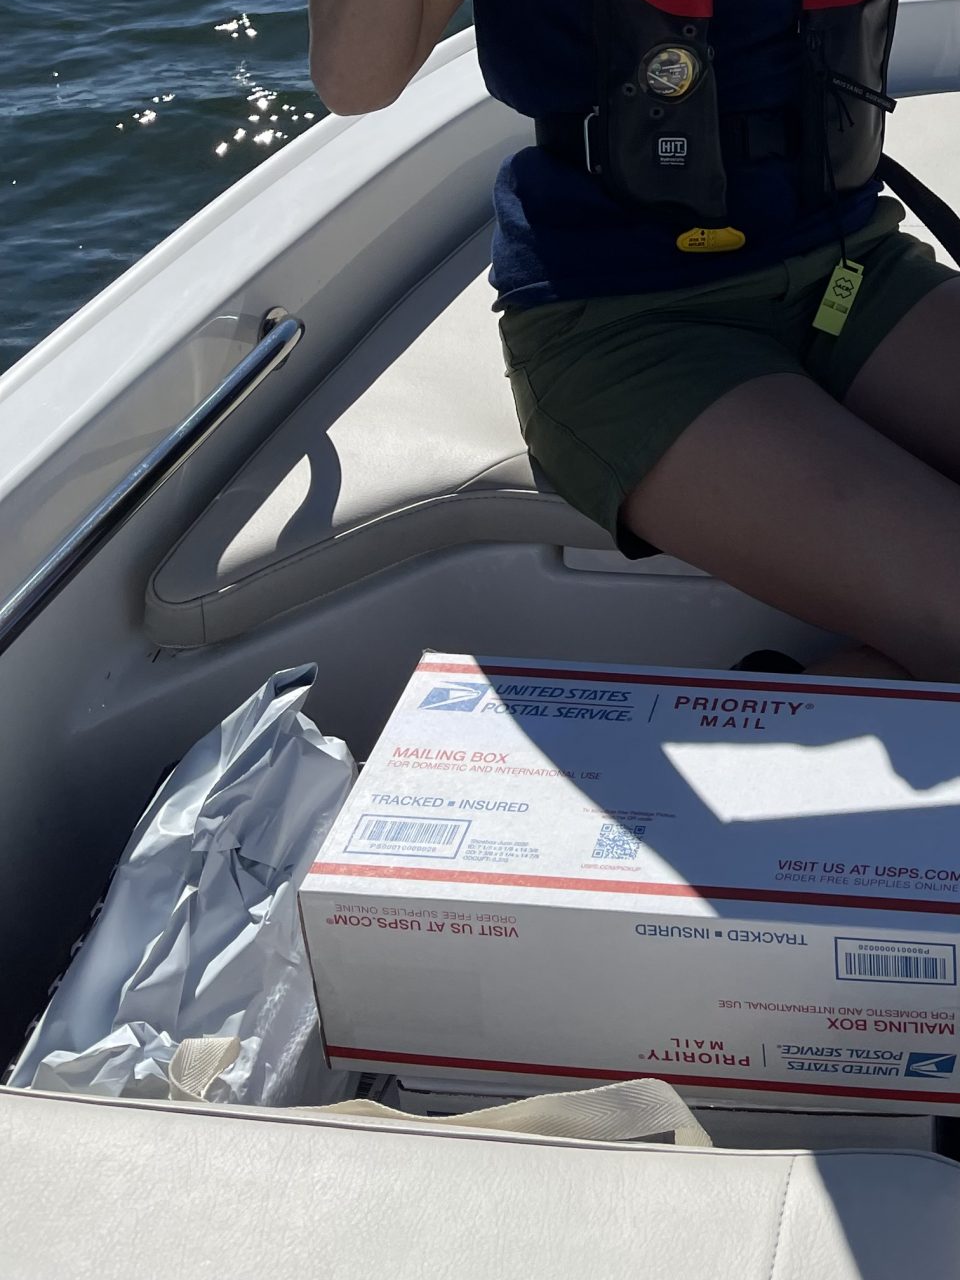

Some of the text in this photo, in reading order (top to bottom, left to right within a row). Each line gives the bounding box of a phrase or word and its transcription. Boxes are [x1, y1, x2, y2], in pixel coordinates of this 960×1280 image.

[662, 141, 684, 153] HIT
[493, 683, 632, 703] UNITED STATES
[481, 702, 552, 719] POSTAL
[698, 714, 768, 730] MAIL
[392, 746, 510, 764] MAILING BOX
[387, 759, 602, 781] FOR DOMESTIC AND INTERNATIONAL USE
[370, 793, 530, 813] TRACKED INSURED
[777, 859, 819, 873] VISIT
[822, 862, 845, 874] US
[849, 864, 871, 876] AT
[774, 872, 960, 893] ORDER FREE SUPPLIES ONLINE
[335, 903, 518, 925] ORDER FREE SUPPLIES ONLINE
[426, 920, 446, 933] AT
[450, 922, 474, 935] US
[477, 924, 520, 938] VISIT
[634, 923, 809, 946] TRACKED INSURED
[717, 999, 956, 1020] FOR DOMESTIC AND INTERNATIONAL USE
[827, 1017, 955, 1036] MAILING BOX
[669, 1037, 725, 1051] MAIL
[846, 1047, 904, 1061] POSTAL
[787, 1059, 900, 1077] UNITED STATES
